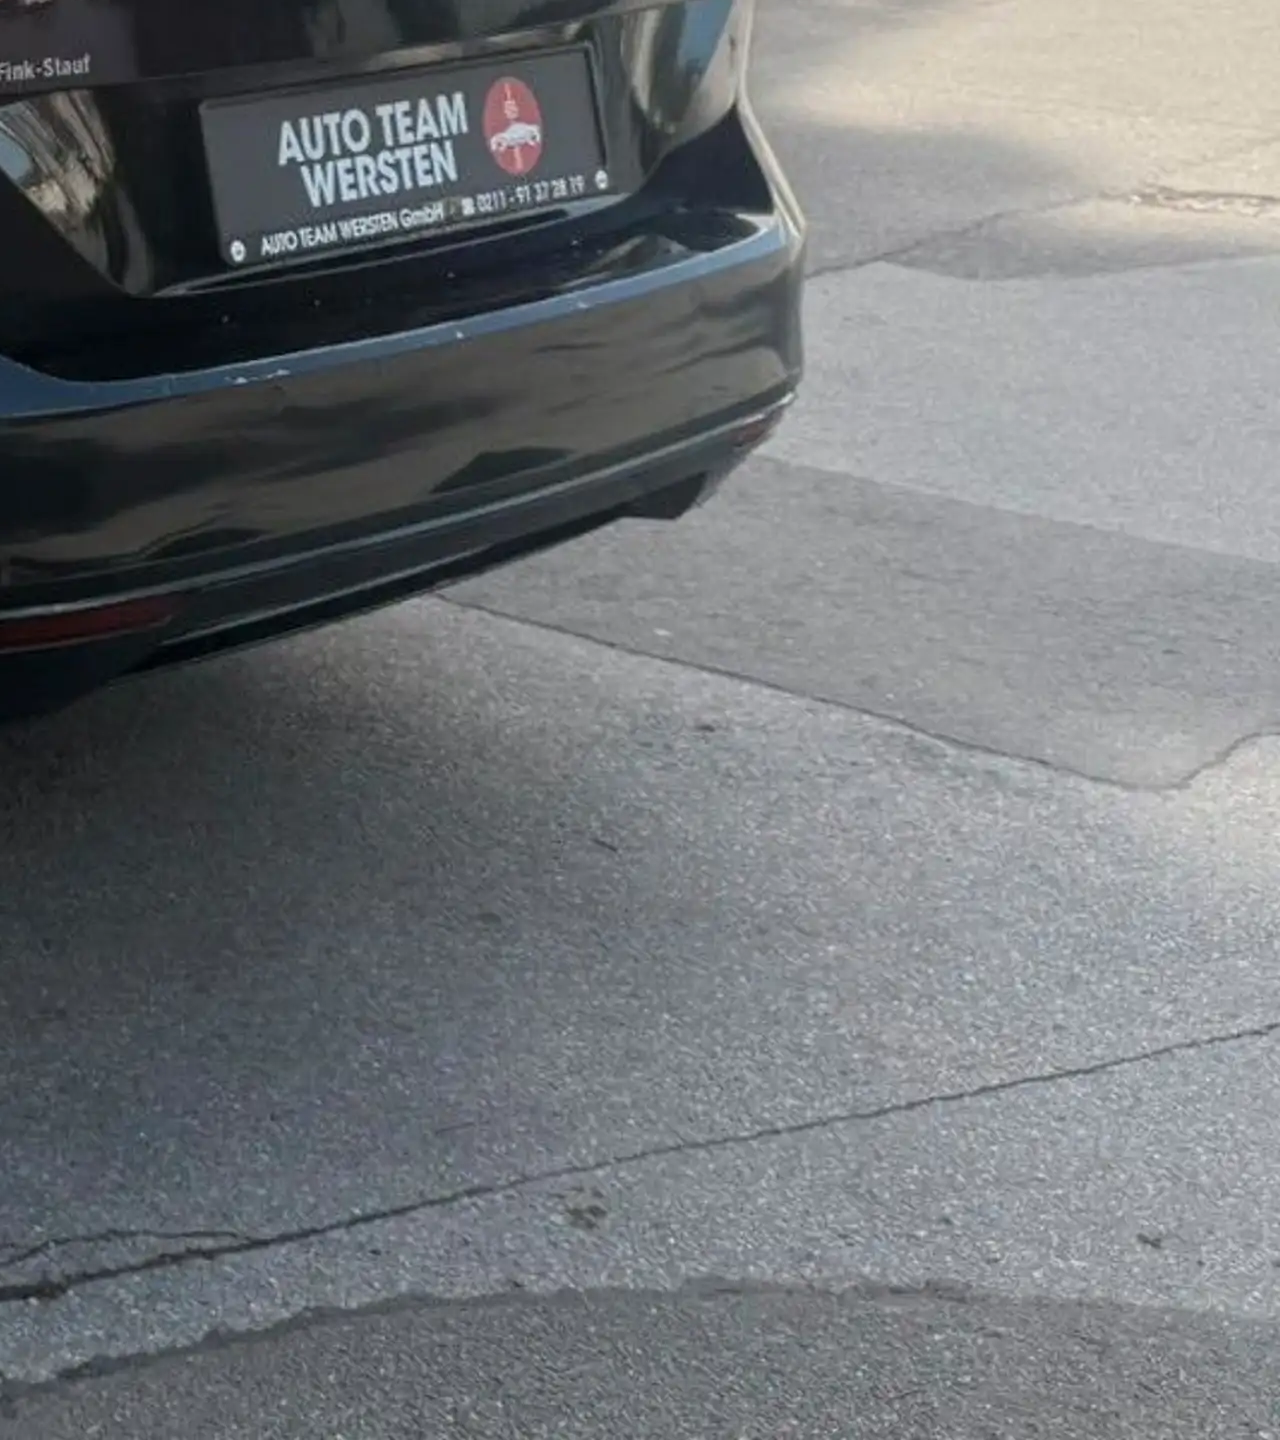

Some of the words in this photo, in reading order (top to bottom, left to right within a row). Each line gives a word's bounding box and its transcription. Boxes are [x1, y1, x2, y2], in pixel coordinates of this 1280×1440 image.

[278, 109, 371, 166] AUTO
[376, 91, 469, 146] TEAM
[301, 139, 458, 208] WERSTEN
[476, 188, 507, 213] 0211
[260, 229, 297, 257] AUTO
[298, 219, 338, 248] TEAM
[338, 211, 399, 240] WERSTEN
[399, 201, 445, 228] GmbH
